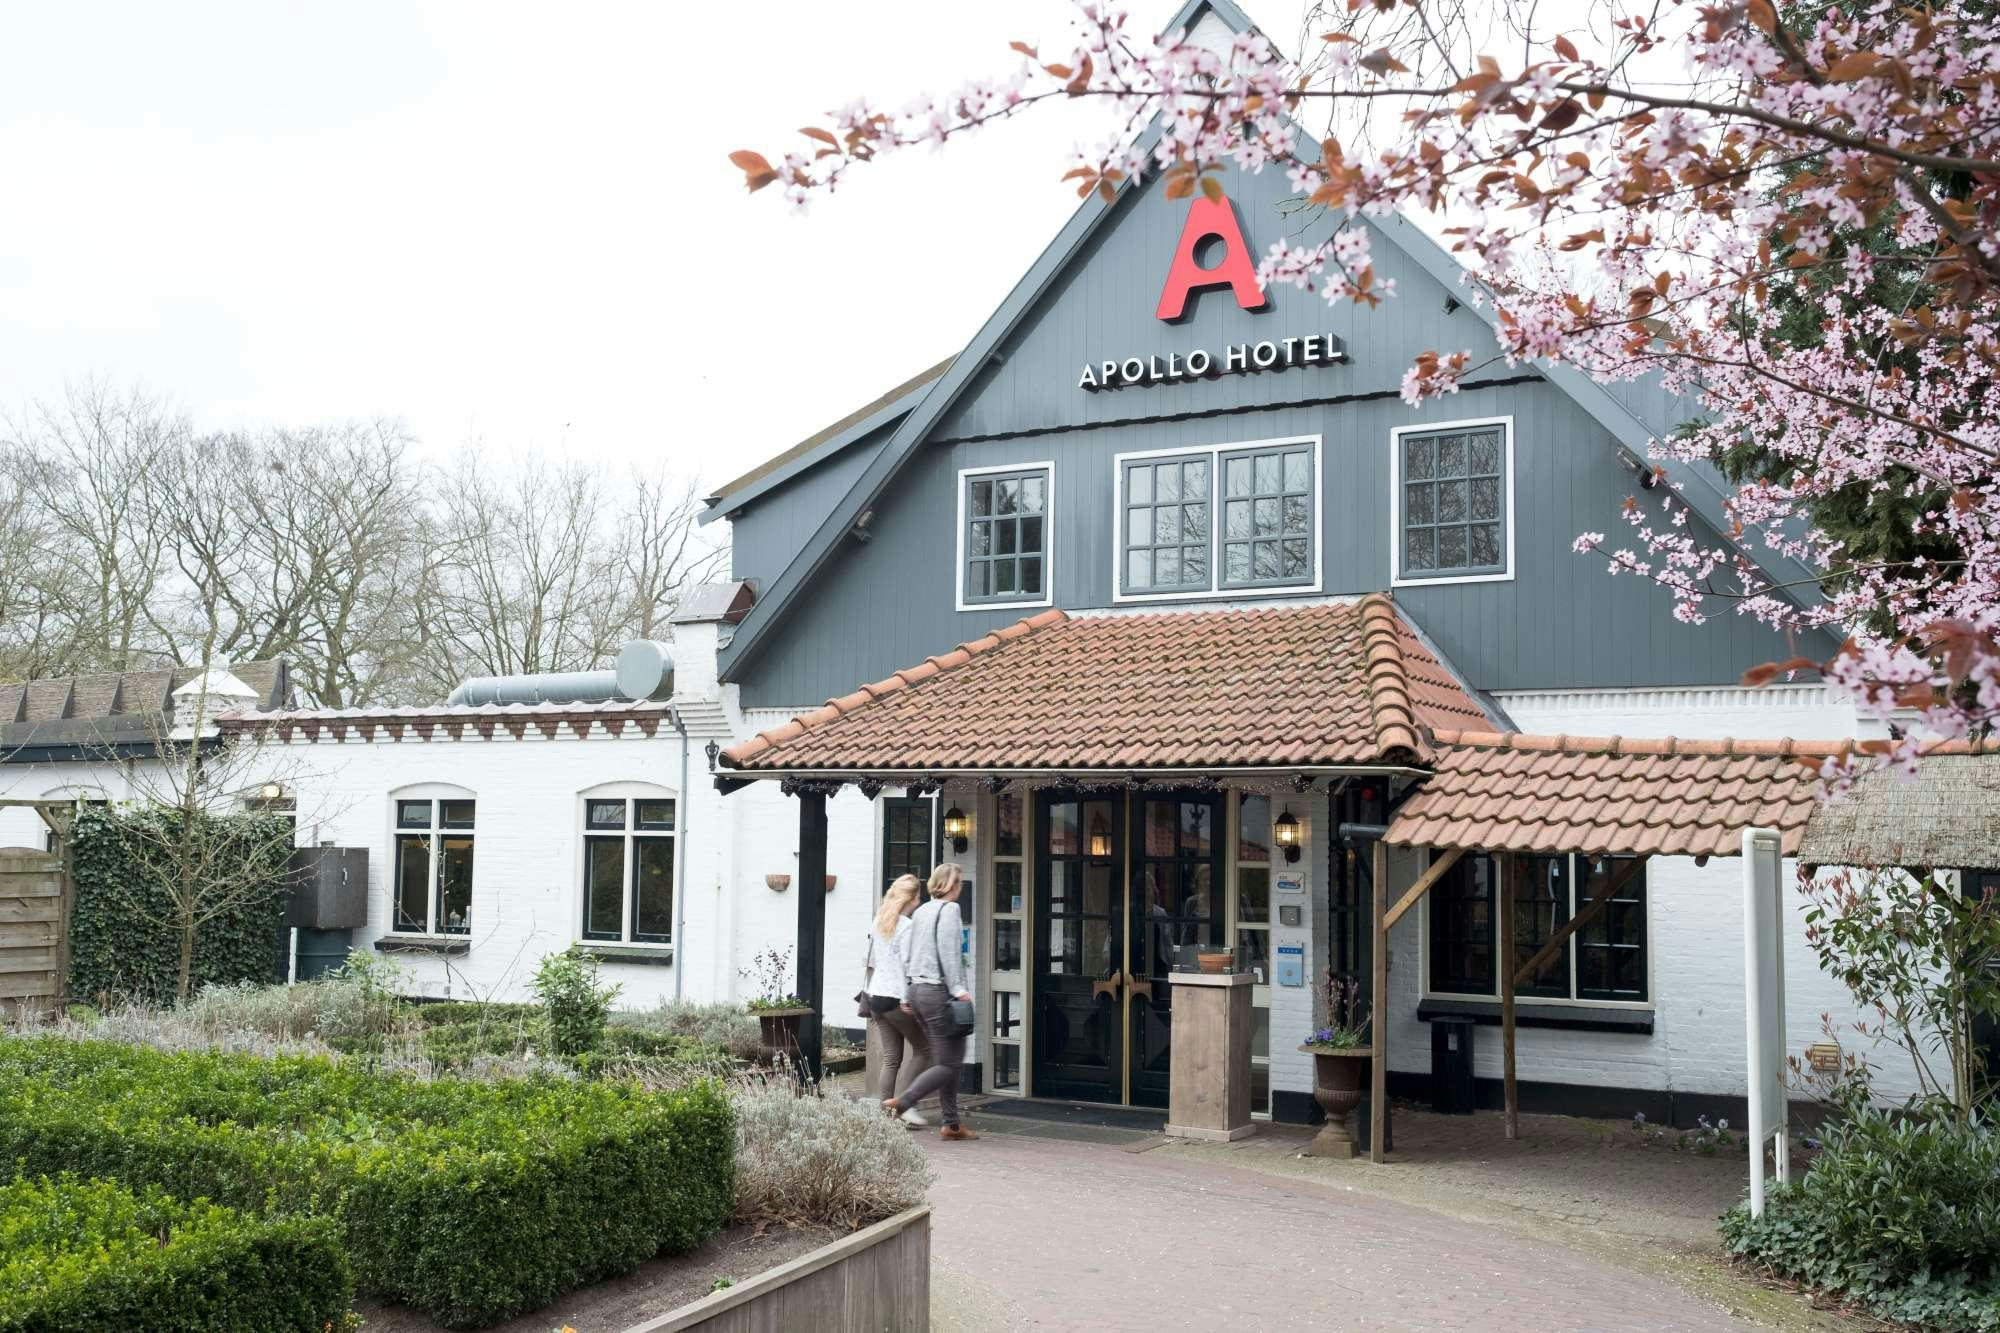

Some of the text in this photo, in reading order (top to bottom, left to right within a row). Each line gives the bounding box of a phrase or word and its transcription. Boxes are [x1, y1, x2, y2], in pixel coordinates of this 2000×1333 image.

[1155, 194, 1267, 320] A
[1078, 332, 1343, 387] APOLLO HOTEL
